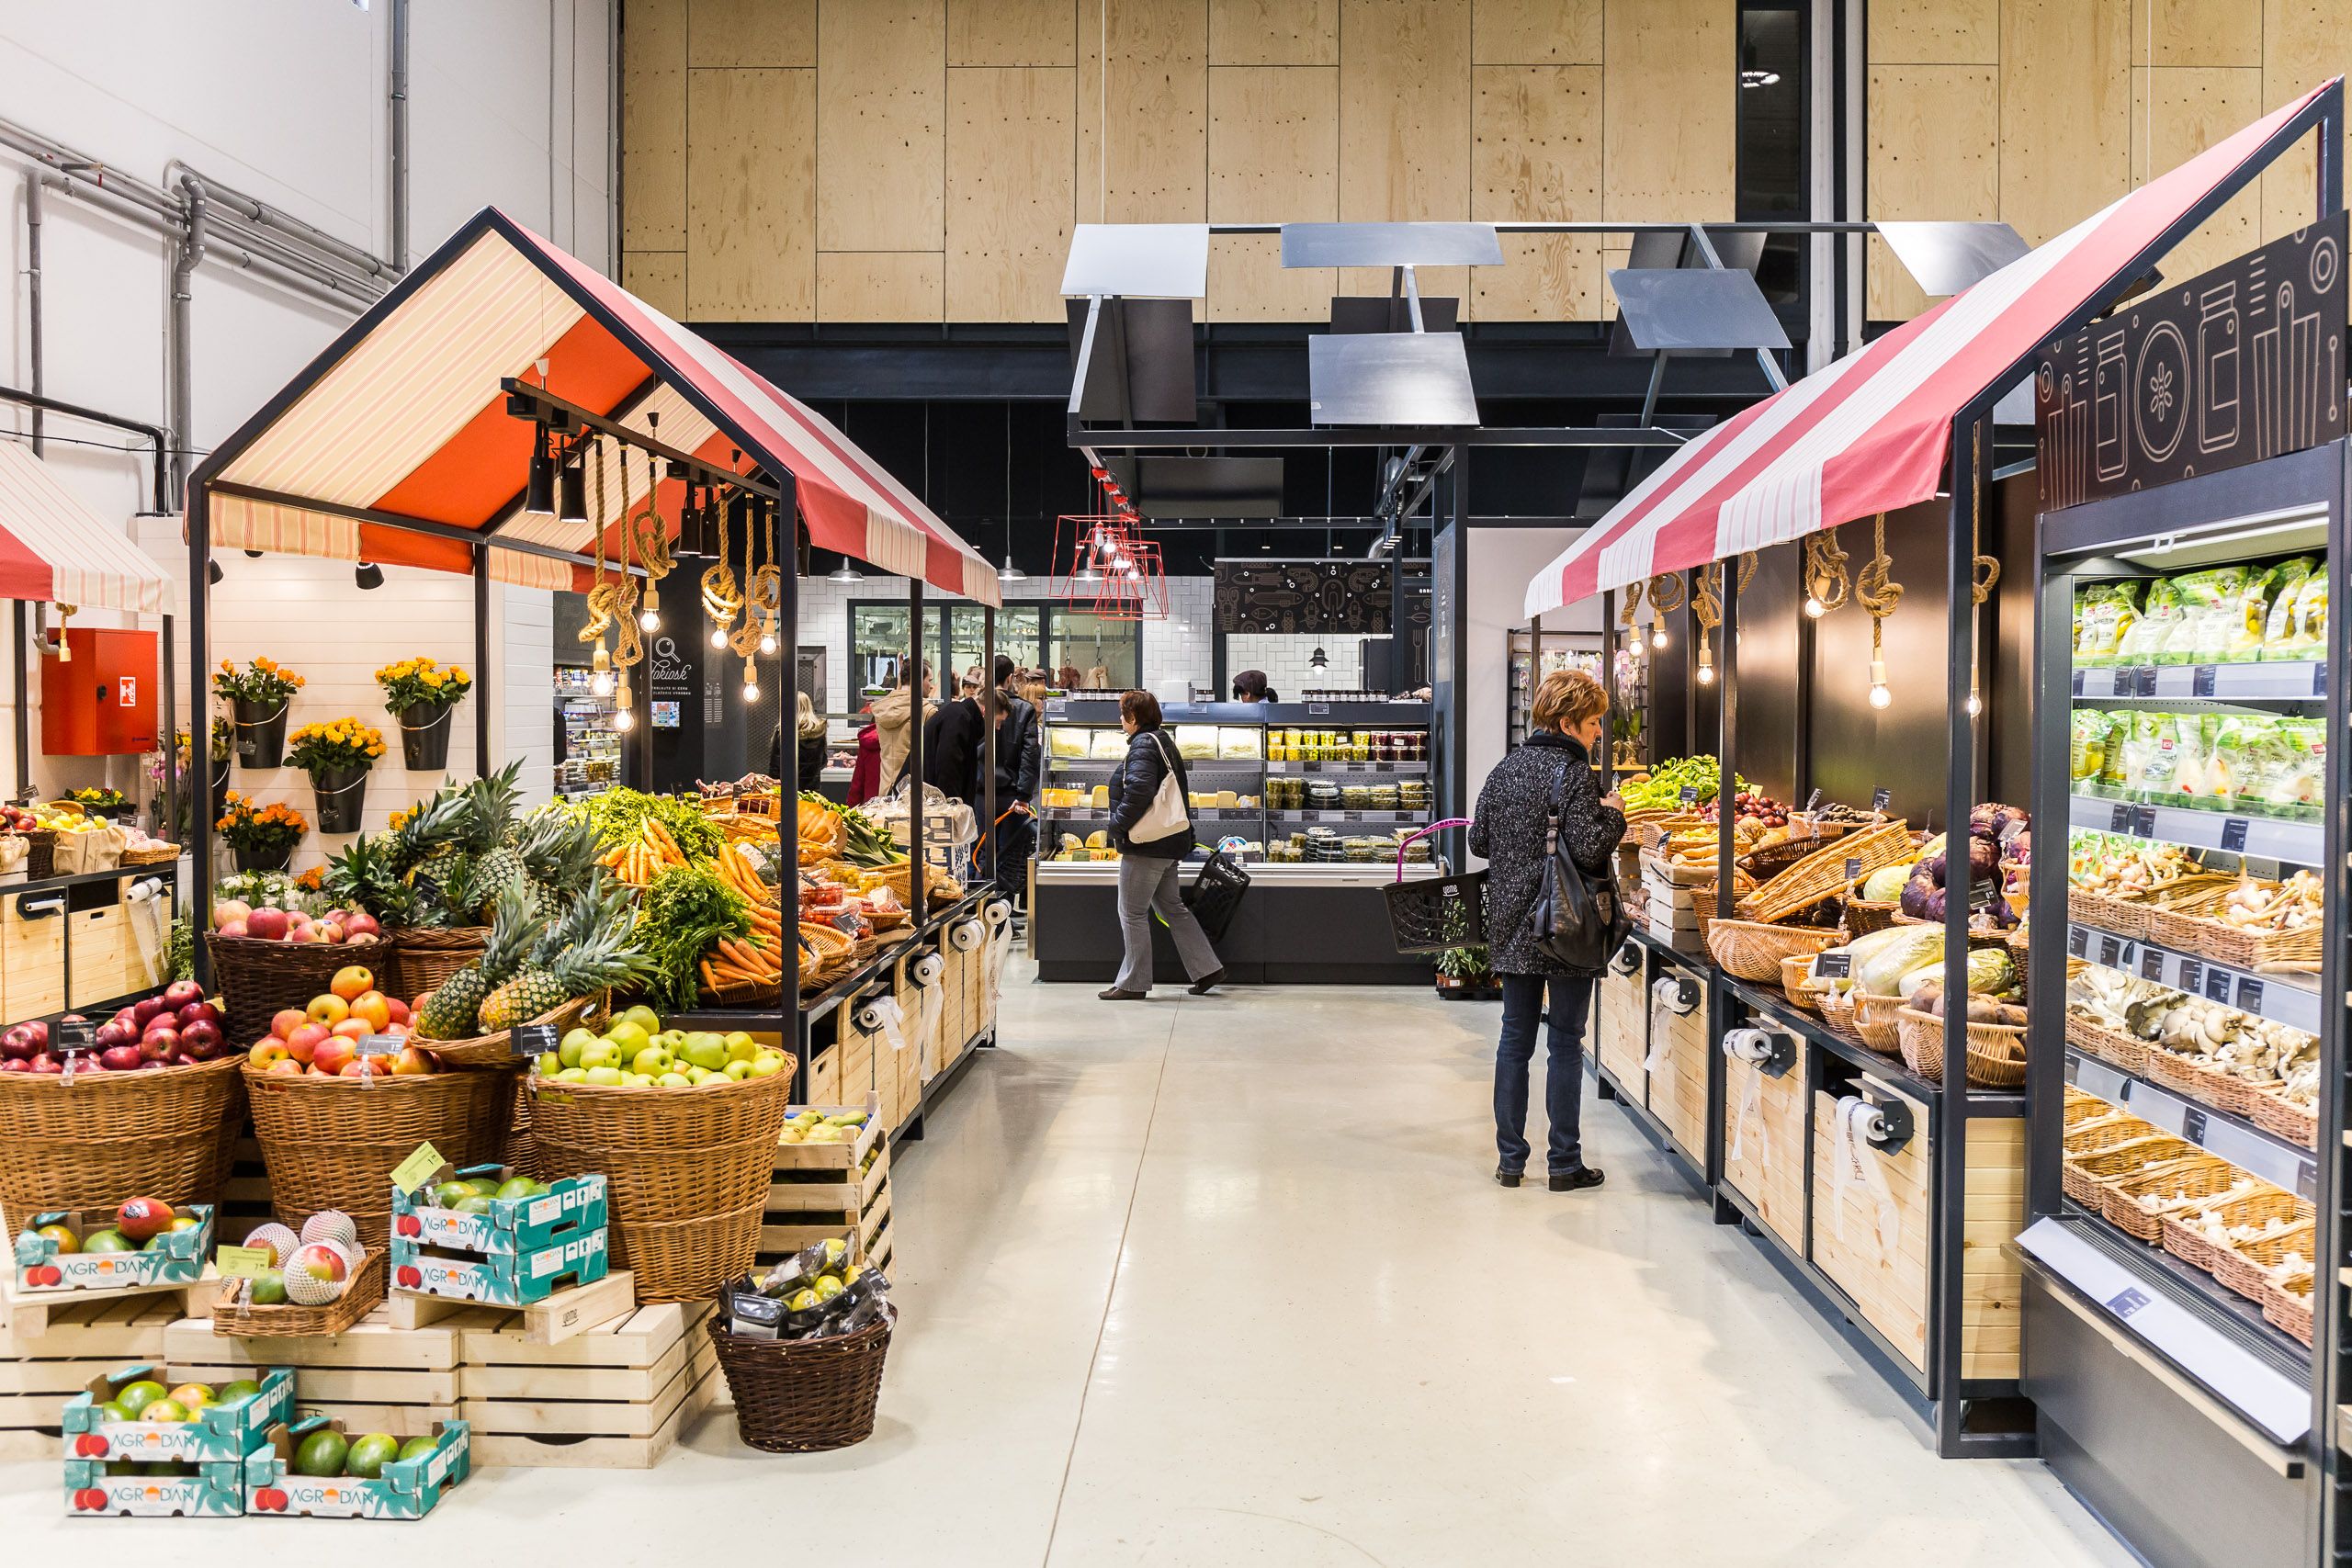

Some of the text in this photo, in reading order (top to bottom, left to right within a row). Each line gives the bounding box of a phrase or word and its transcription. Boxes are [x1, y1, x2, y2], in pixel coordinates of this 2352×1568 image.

[64, 1259, 151, 1276] AGRODAN
[111, 1432, 196, 1449] AGRODAN
[109, 1486, 194, 1502] AGRODAN
[290, 1488, 374, 1505] AGRODAN
